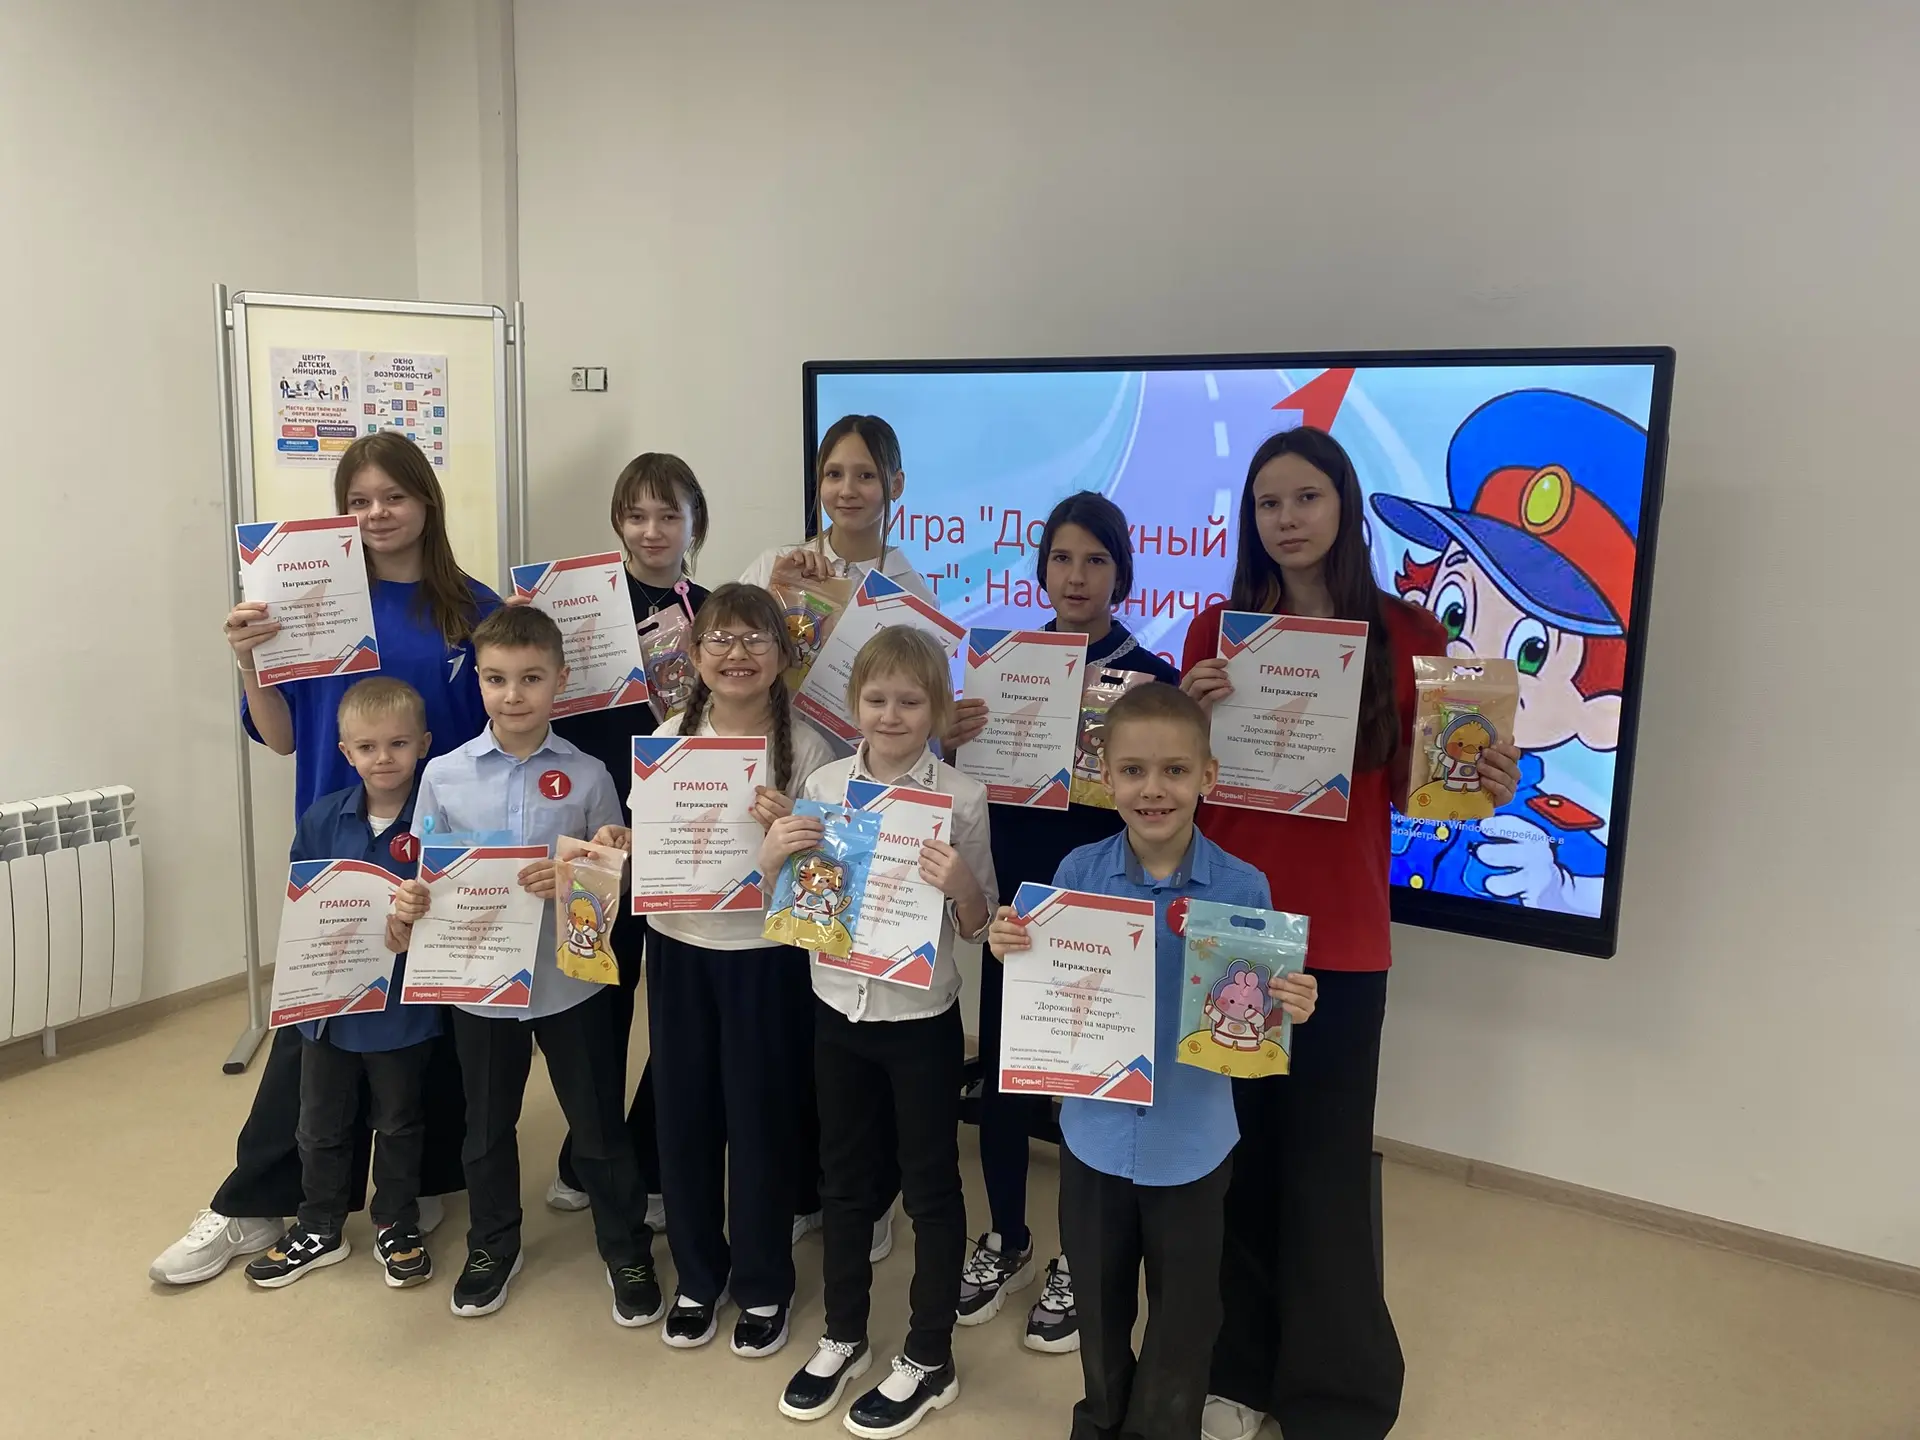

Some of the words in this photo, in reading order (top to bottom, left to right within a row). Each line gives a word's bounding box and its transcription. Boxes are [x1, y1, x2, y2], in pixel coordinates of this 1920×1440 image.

[374, 371, 432, 379] ВОЗМОЖНОСТЕЙ
[887, 505, 965, 551] Игра
[277, 559, 330, 572] ГРАМОТА
[282, 578, 332, 588] Награждается
[289, 603, 314, 611] участие
[552, 595, 598, 609] ГРАМОТА
[326, 617, 358, 625] маршруте
[557, 612, 601, 624] Награждается
[291, 629, 335, 638] безопасности
[571, 662, 607, 671] езопасности
[1260, 665, 1320, 679] ГРАМОТА
[1001, 673, 1050, 685] ГРАМОТА
[1261, 686, 1318, 698] Награждается
[1001, 693, 1048, 702] Награждается
[1262, 715, 1289, 724] победу
[985, 728, 1021, 736] "Дорожный
[1241, 724, 1284, 735] "Дорожный
[1227, 736, 1285, 747] наставничество
[1298, 743, 1336, 754] маршруте
[996, 749, 1037, 758] безопасности
[1254, 749, 1305, 760] безопасности
[673, 782, 728, 791] ГРАМОТА
[1216, 791, 1243, 800] Первые
[676, 801, 728, 809] Награждается
[1450, 822, 1496, 835] Windows,
[1500, 829, 1555, 843] перейдите
[660, 838, 701, 846] "Дорожный
[879, 832, 920, 848] РАМОТА
[457, 887, 510, 896] ГРАМОТА
[320, 900, 371, 909] ГРАМОТА
[895, 909, 927, 921] маршруте
[319, 917, 368, 925] Награждается
[1050, 937, 1112, 956] ГРАМОТА
[449, 952, 494, 960] безопасности
[289, 960, 337, 971] наставничество
[1053, 960, 1112, 975] Награждается
[312, 968, 353, 976] безопасности
[1055, 991, 1085, 1000] участие
[1095, 996, 1112, 1004] игре
[1035, 1001, 1080, 1014] "Дорожный
[1020, 1014, 1082, 1025] наставничество
[1096, 1022, 1135, 1033] маршруте
[1051, 1027, 1104, 1040] безопасности
[1012, 1077, 1041, 1086] Первые
